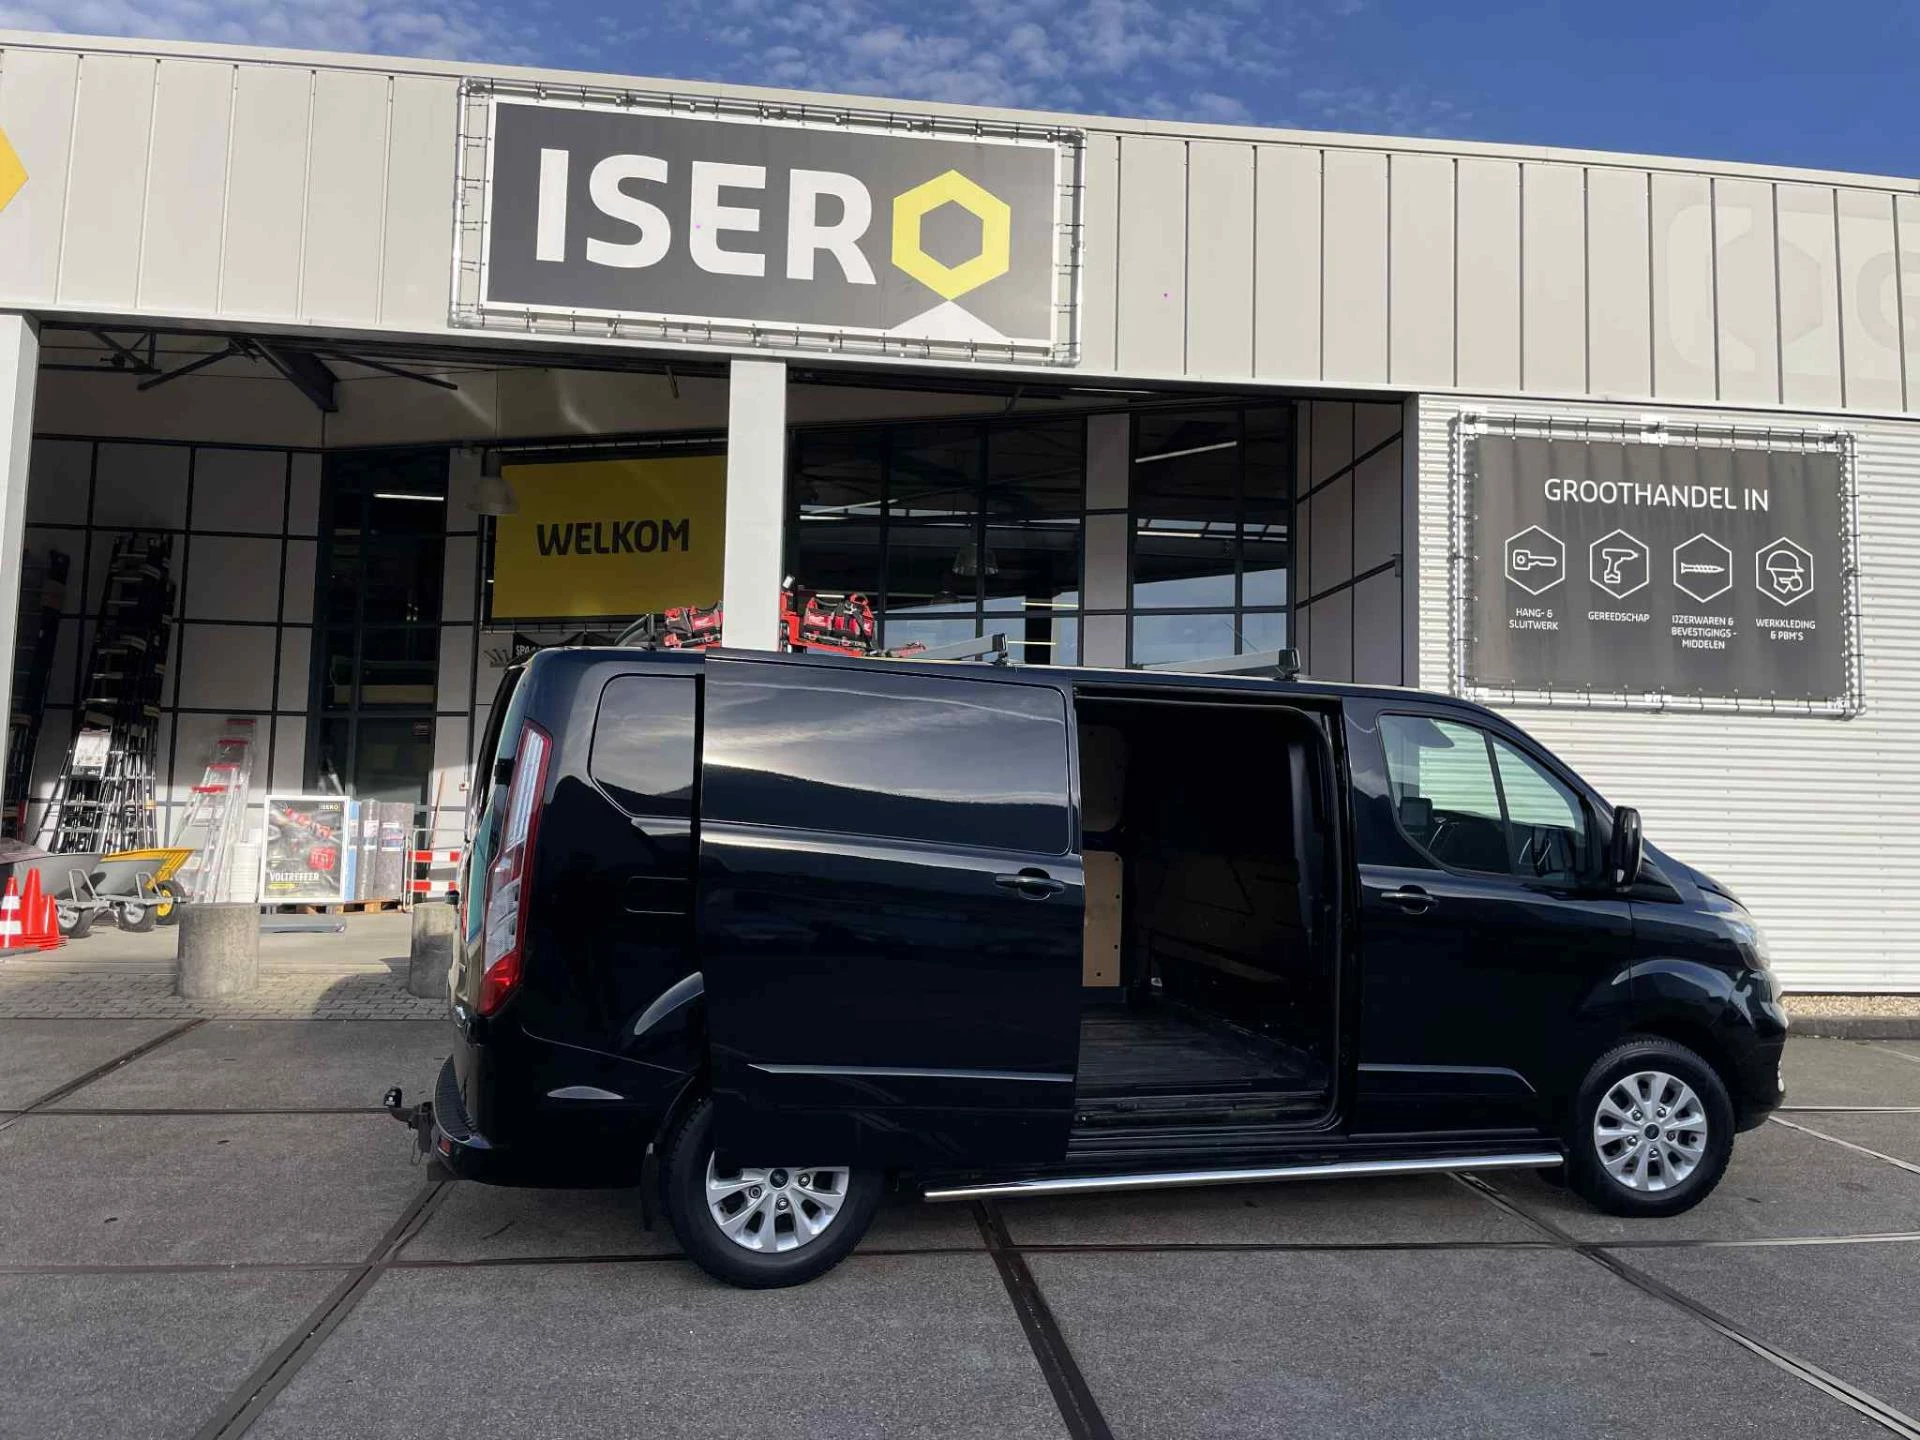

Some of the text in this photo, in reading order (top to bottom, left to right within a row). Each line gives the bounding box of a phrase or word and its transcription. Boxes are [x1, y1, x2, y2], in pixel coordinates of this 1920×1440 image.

[535, 148, 1011, 300] ISERO
[1544, 478, 1769, 512] GROOTHANDEL IN
[536, 518, 690, 557] WELKOM
[1516, 608, 1553, 618] HANG- &
[1588, 611, 1650, 623] GEREEDSCHAP
[1508, 619, 1559, 631] SLUITWERK
[1671, 614, 1734, 626] IJZERWAREN &
[1755, 618, 1816, 630] WERKKLEDING
[1770, 630, 1804, 641] & PBM'S
[1681, 639, 1725, 649] MIDDELEN
